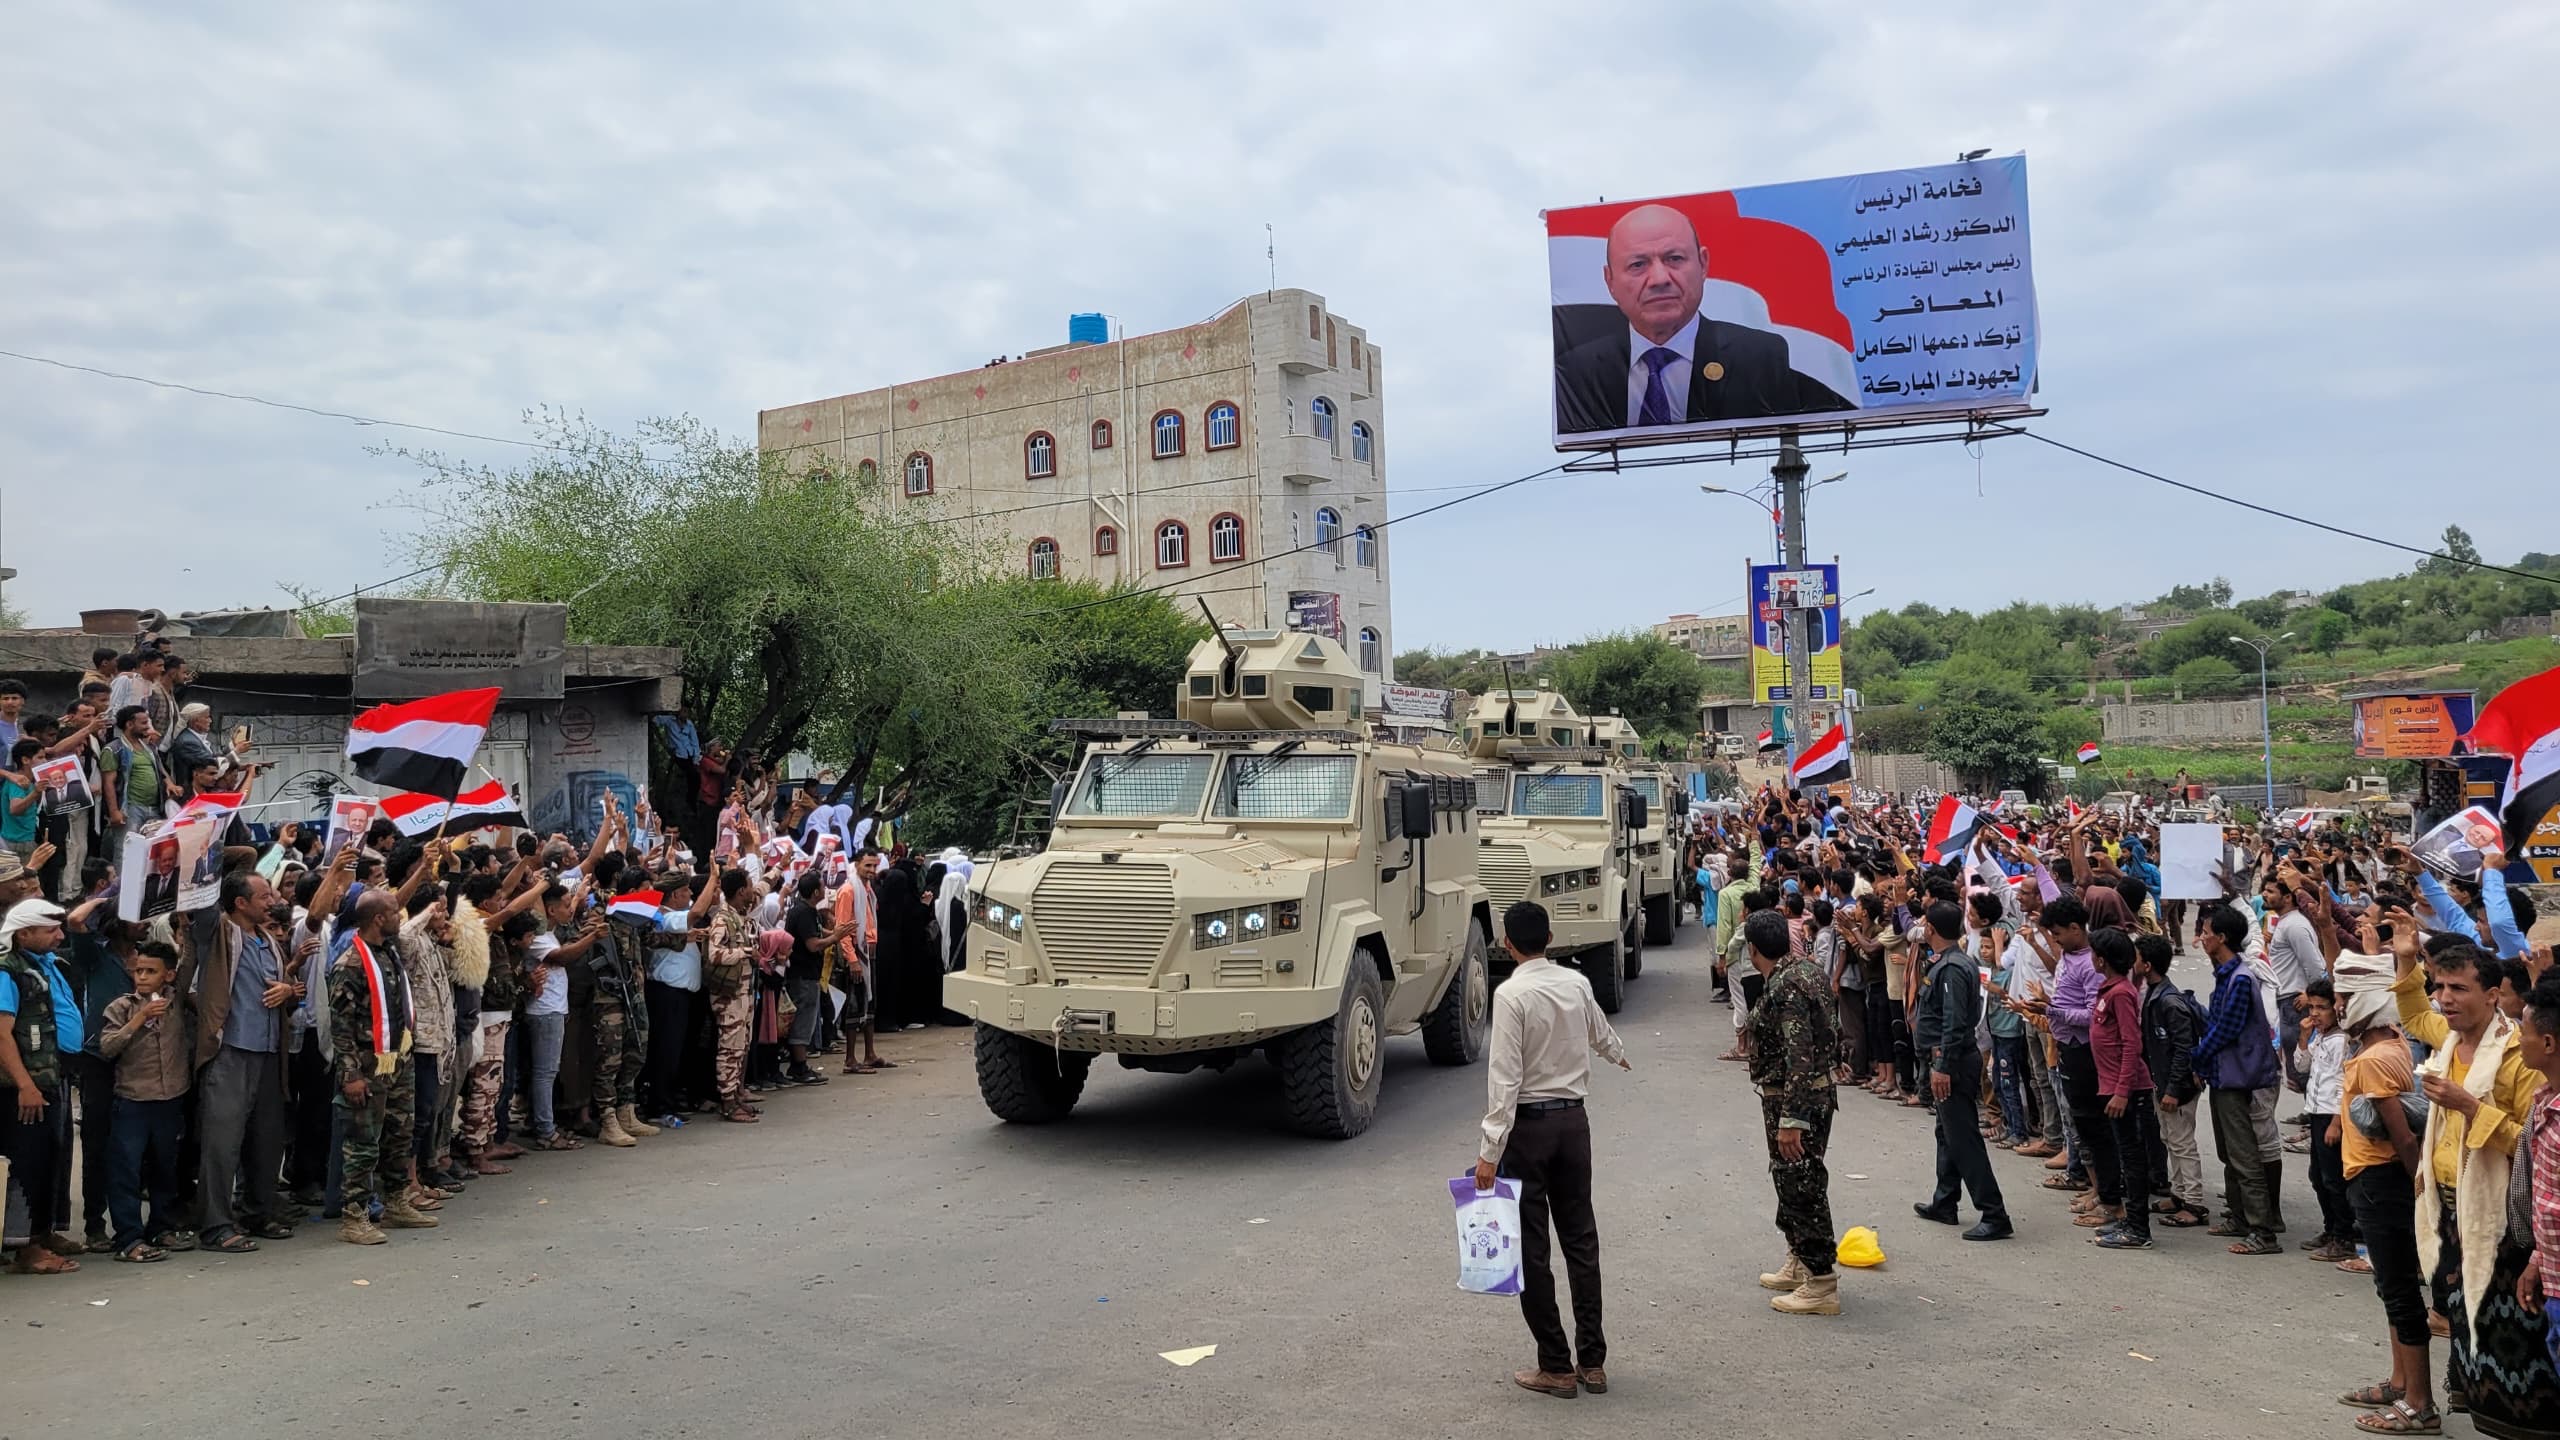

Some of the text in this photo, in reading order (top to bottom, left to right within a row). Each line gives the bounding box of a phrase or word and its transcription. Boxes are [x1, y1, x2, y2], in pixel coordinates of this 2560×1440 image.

[1855, 177, 1982, 214] فخامة الرئيس
[1834, 216, 2016, 256] الدكتور رشاد العليمي
[1894, 260, 1938, 280] القيادة
[1941, 258, 1982, 277] مجلس
[1985, 253, 2021, 274] رئيس
[1855, 324, 2021, 363] تؤكد دعمها الكامل
[1862, 363, 2021, 396] لجهودك المباركة
[1799, 589, 1825, 607] 7162
